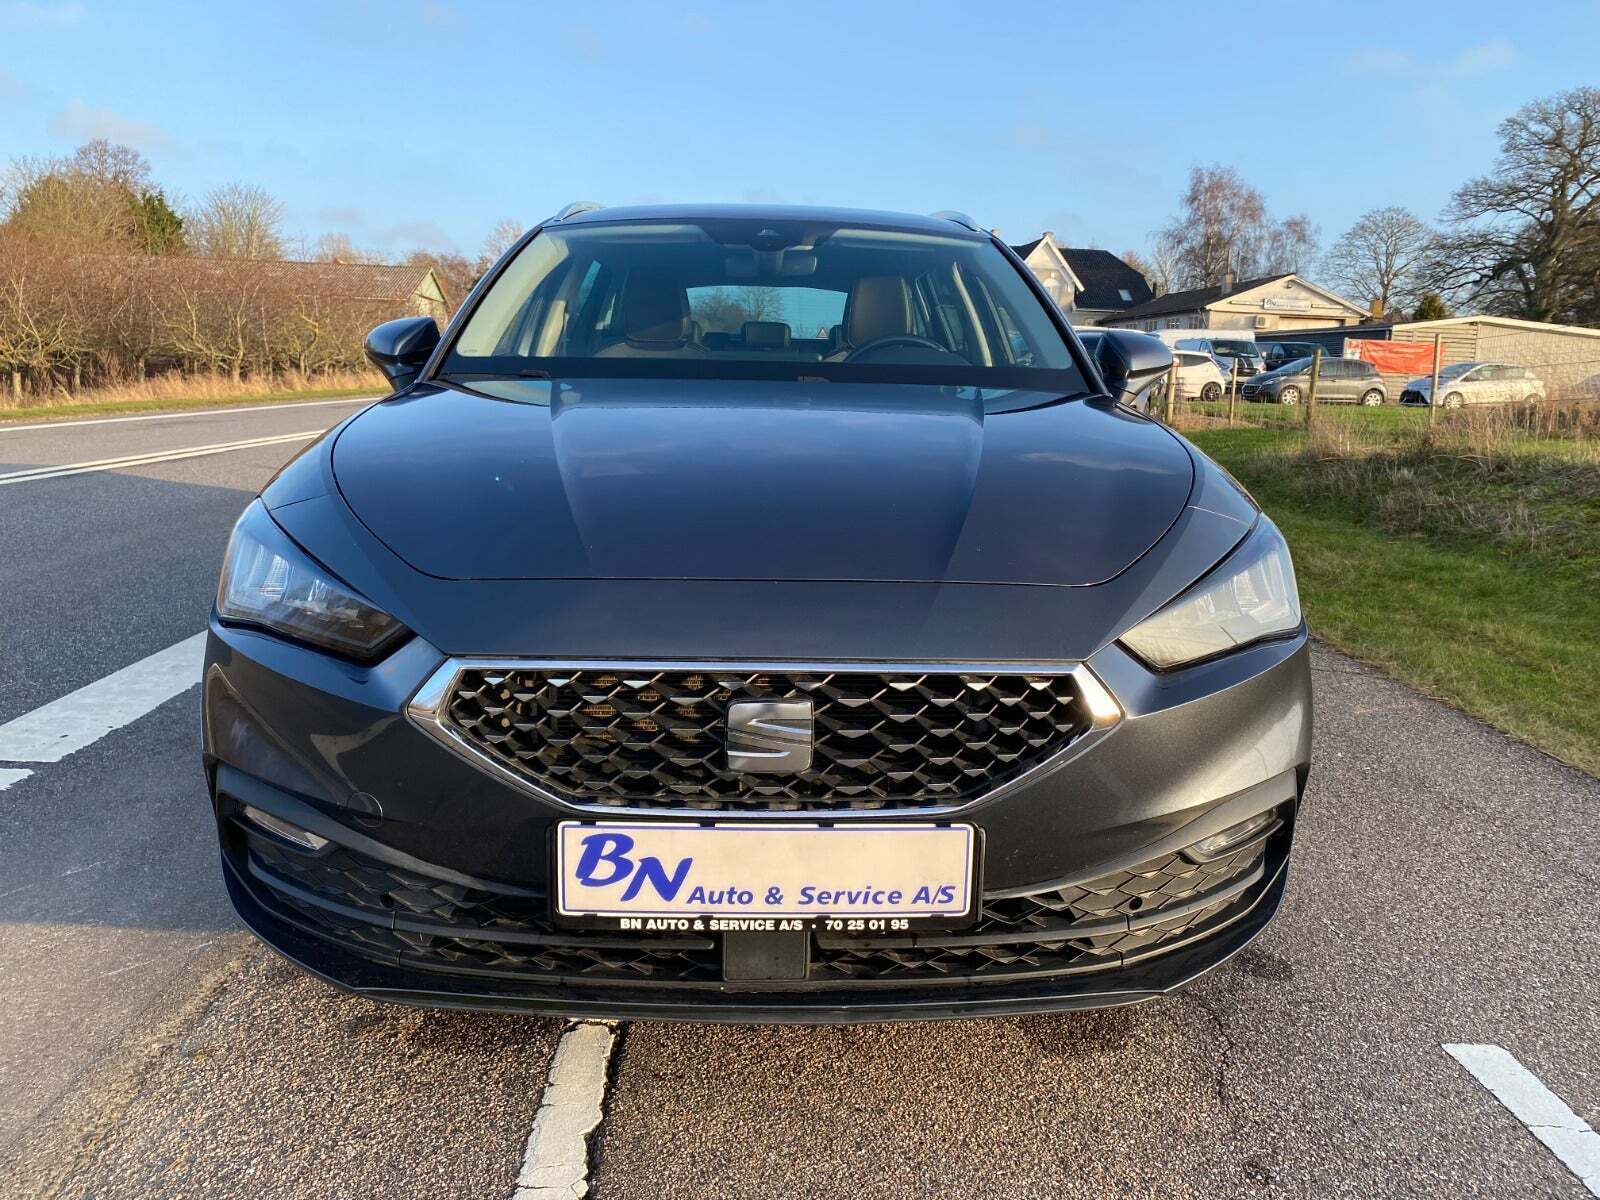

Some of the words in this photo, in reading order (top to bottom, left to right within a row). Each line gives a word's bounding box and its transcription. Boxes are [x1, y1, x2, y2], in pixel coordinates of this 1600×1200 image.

[576, 832, 693, 902] BN
[687, 886, 753, 905] Auto
[764, 886, 783, 905] &
[799, 886, 903, 905] Service
[911, 886, 956, 905] A/S
[620, 918, 642, 931] BN
[645, 918, 689, 931] AUTO
[692, 918, 705, 931] &
[708, 918, 775, 932] SERVICE
[778, 919, 804, 932] A/S
[823, 919, 844, 931] 70
[846, 919, 866, 931] 25
[867, 919, 887, 931] 01
[889, 919, 910, 931] 95
